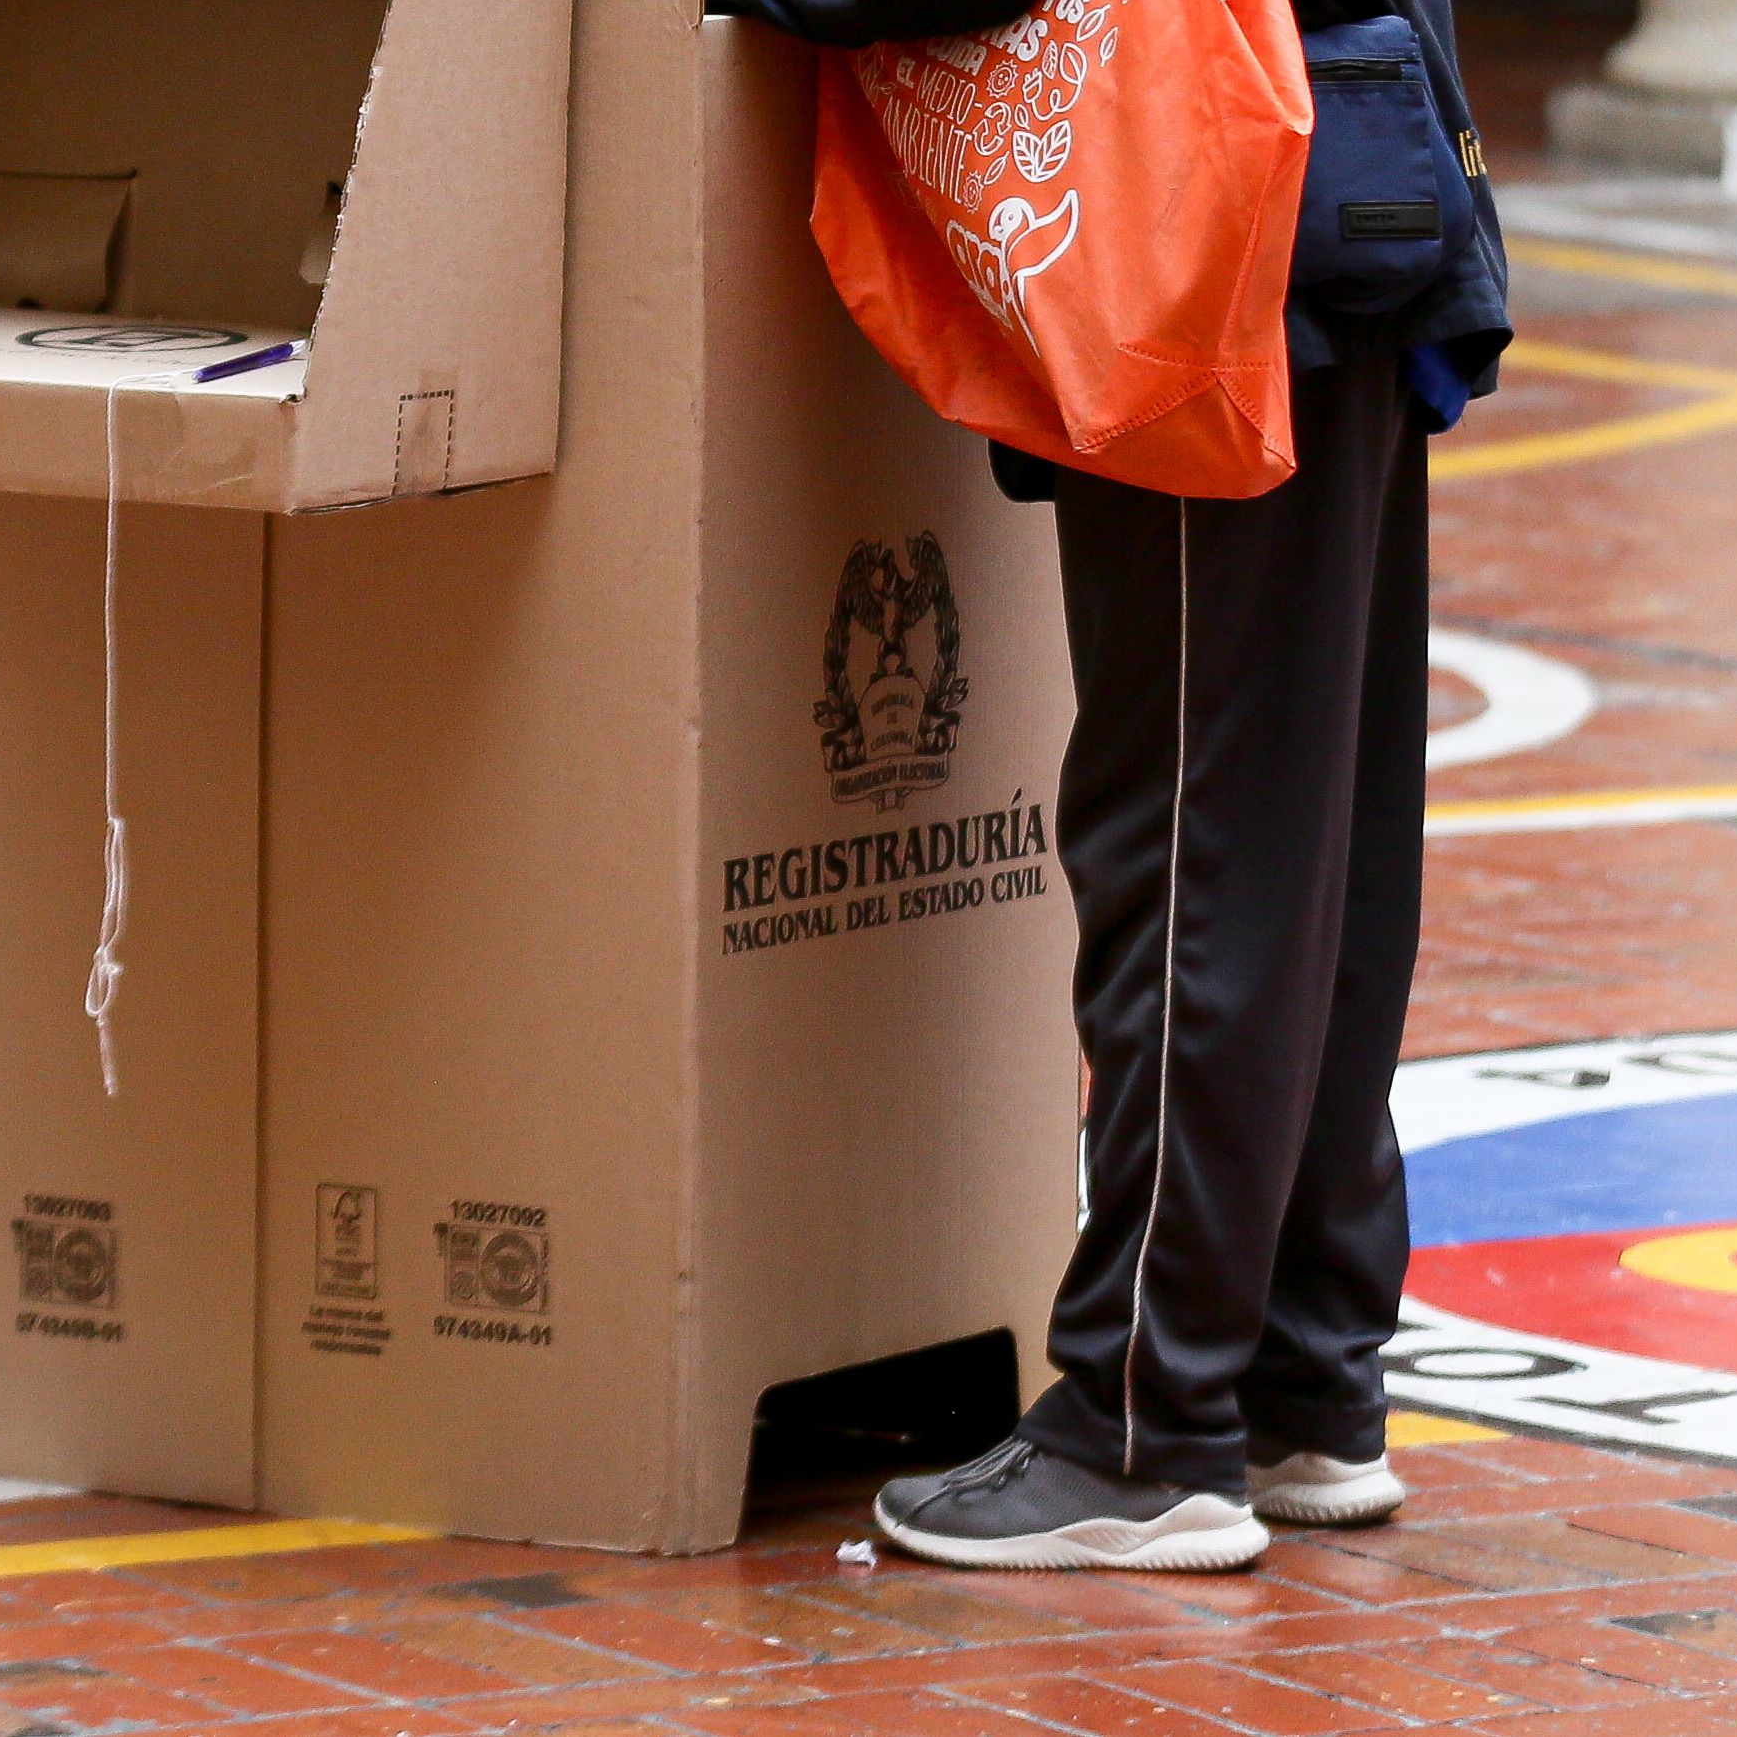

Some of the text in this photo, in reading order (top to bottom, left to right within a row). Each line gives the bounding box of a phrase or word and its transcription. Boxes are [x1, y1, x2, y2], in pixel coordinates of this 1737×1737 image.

[723, 787, 1048, 913] REGISTRADURÍA
[722, 865, 1048, 955] NACIONAL DEL ESTADO CIVIL
